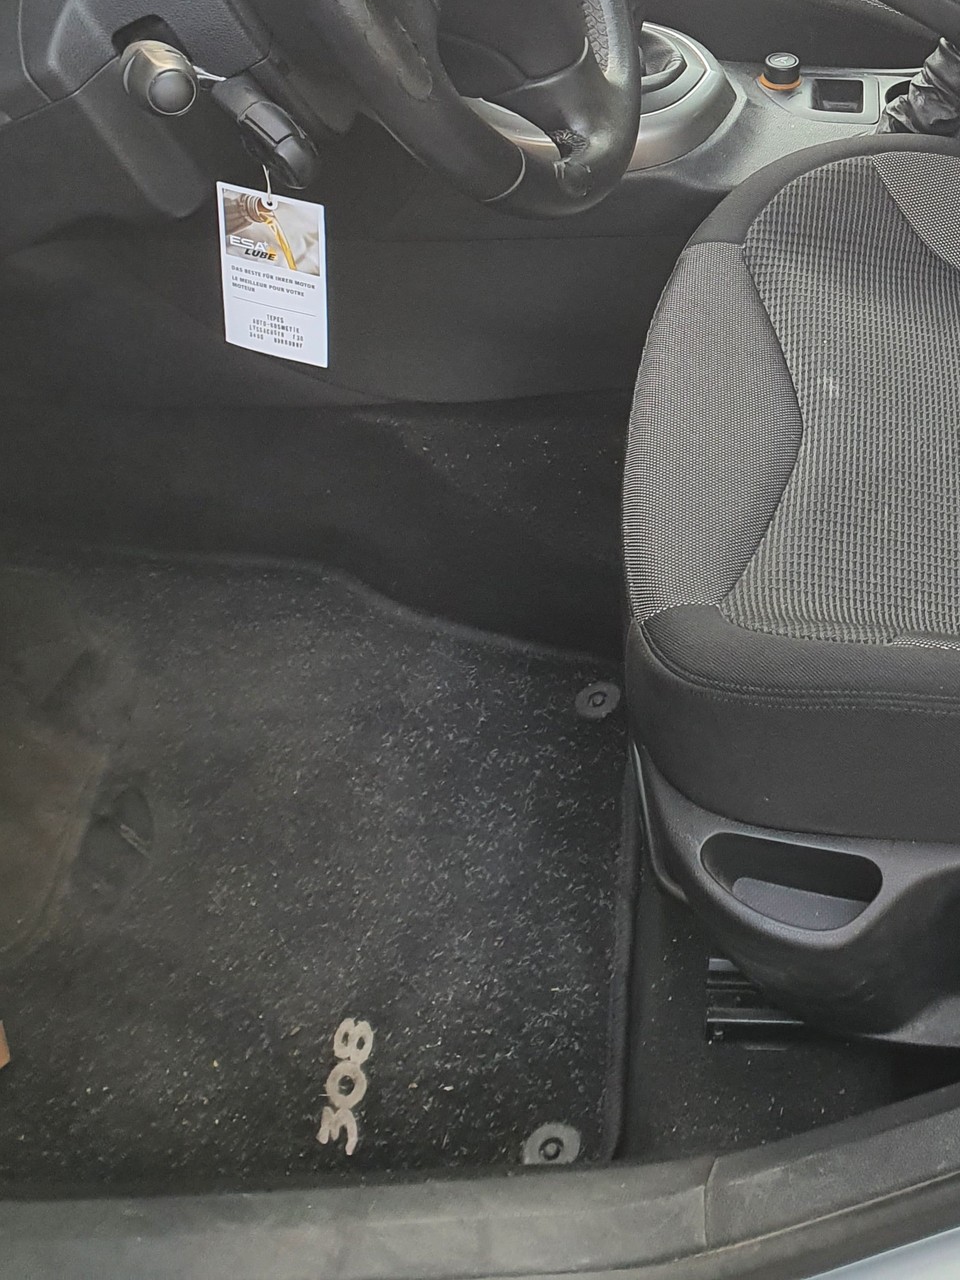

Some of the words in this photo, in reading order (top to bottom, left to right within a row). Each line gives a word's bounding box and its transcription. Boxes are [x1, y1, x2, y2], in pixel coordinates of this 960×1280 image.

[244, 248, 277, 261] LUBE
[244, 268, 261, 277] BESTE
[262, 272, 274, 280] FÜR
[275, 276, 293, 284] IHREN
[294, 280, 316, 289] MOTOR
[232, 282, 256, 293] MOTEUR
[239, 277, 267, 289] MEILLEUR
[269, 284, 285, 292] POUR
[286, 288, 305, 297] VOTRE
[252, 318, 300, 334] AUTO-KOSMETIK
[266, 314, 285, 323] TEPES
[316, 1017, 374, 1156] 308
